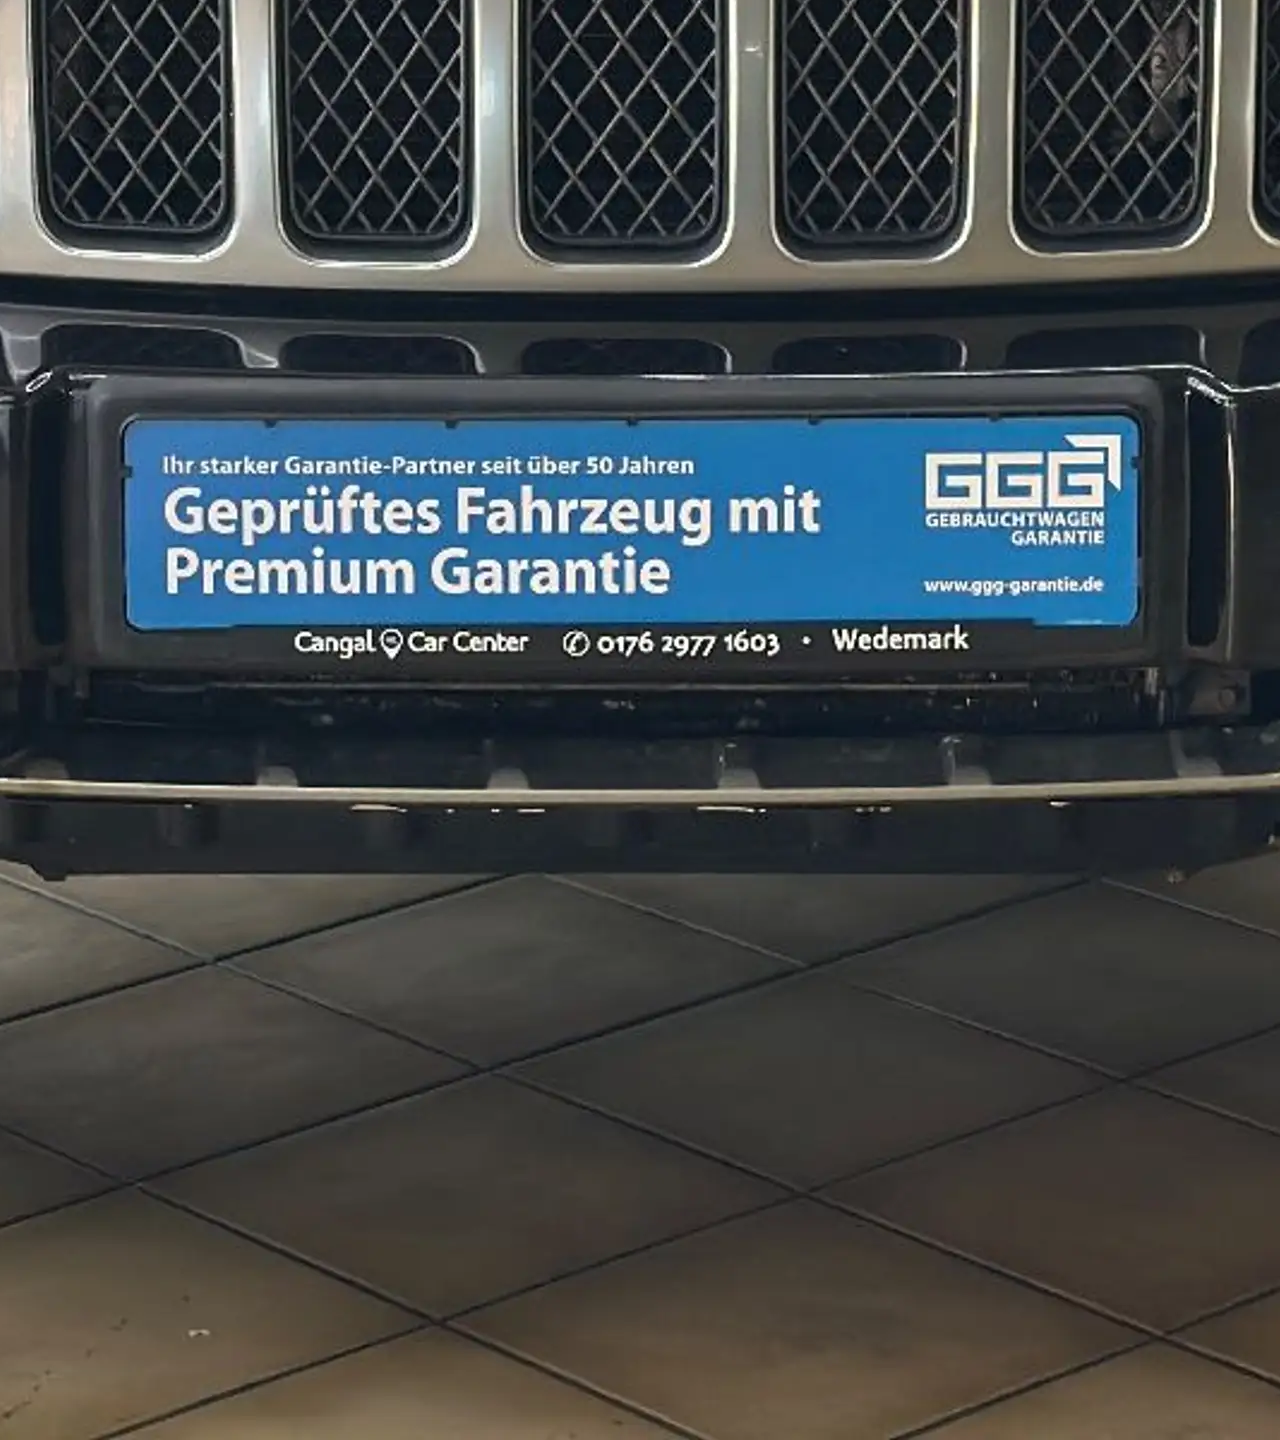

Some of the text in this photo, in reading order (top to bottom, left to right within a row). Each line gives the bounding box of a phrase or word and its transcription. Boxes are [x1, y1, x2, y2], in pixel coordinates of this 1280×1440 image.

[163, 456, 694, 475] Ihr starker Garantie-Partner seit über 50 Jahren
[925, 451, 1105, 509] GGG
[164, 484, 821, 547] Geprüftes Fahrzeug mit
[925, 511, 1105, 528] GEBRAUCHTWAGEN
[1011, 529, 1105, 547] GARANTIE
[166, 545, 671, 594] Premium Garantie
[924, 576, 1104, 596] www.ggg-garantie.de
[294, 624, 970, 659] Cangal Car Center 0176 2977 1603 Wedemark
